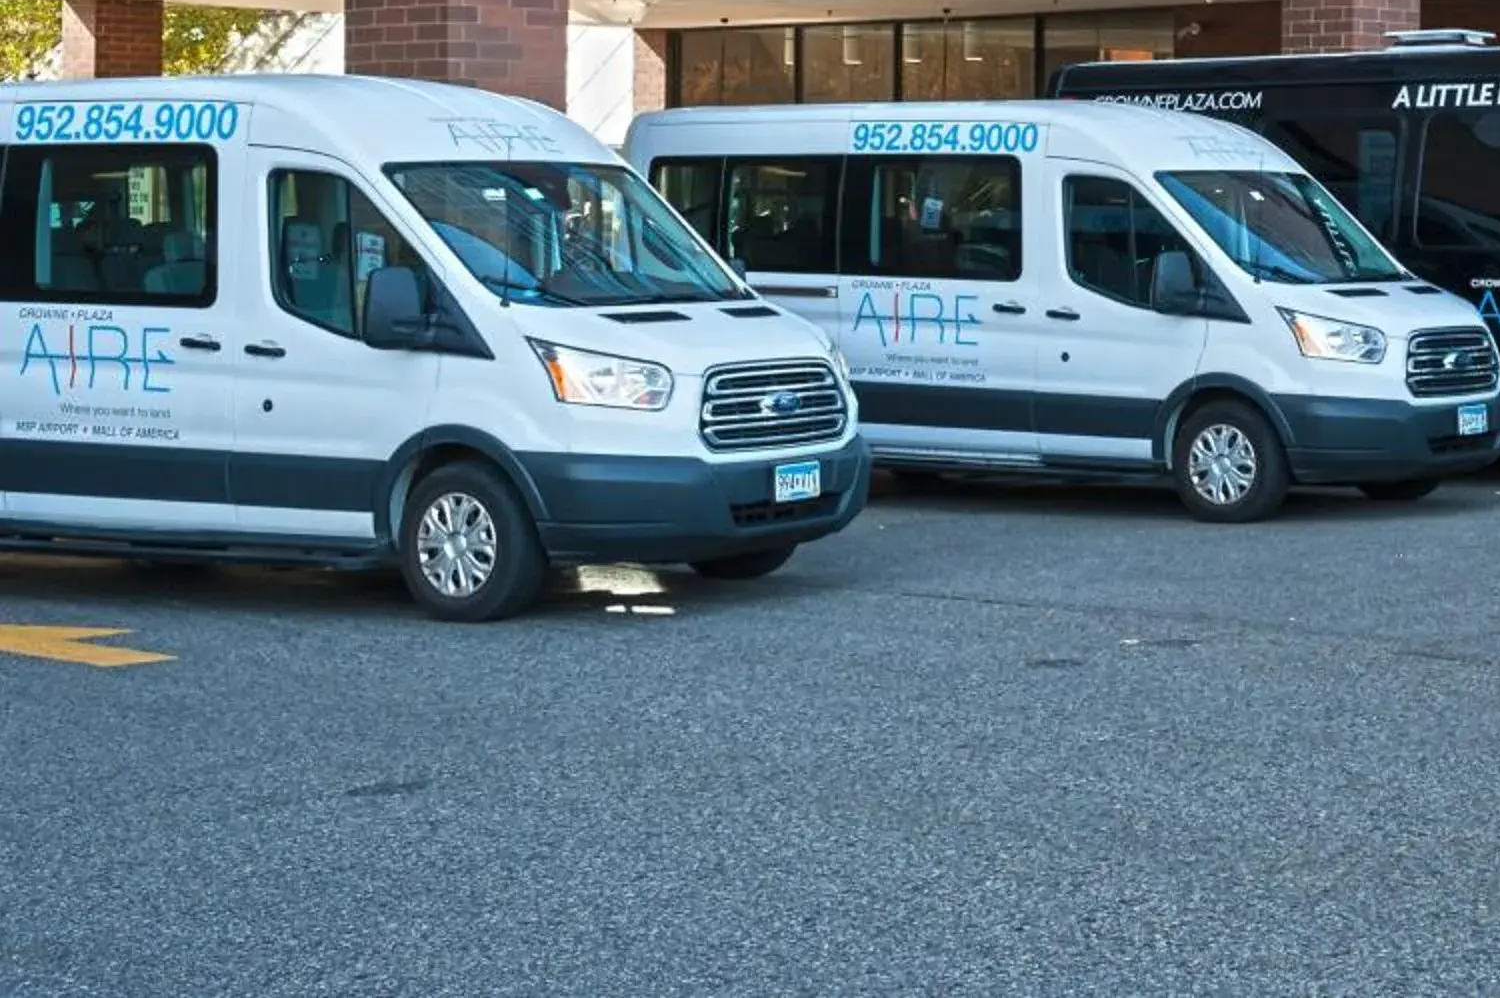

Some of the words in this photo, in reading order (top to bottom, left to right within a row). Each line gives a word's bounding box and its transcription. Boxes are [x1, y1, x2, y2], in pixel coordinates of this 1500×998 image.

[1391, 85, 1411, 109] A
[1415, 83, 1495, 108] LITTLE
[15, 103, 239, 141] 952.854.9000
[853, 122, 1039, 152] 952.854.9000
[852, 291, 984, 347] AIRE
[20, 322, 175, 396] AIRE
